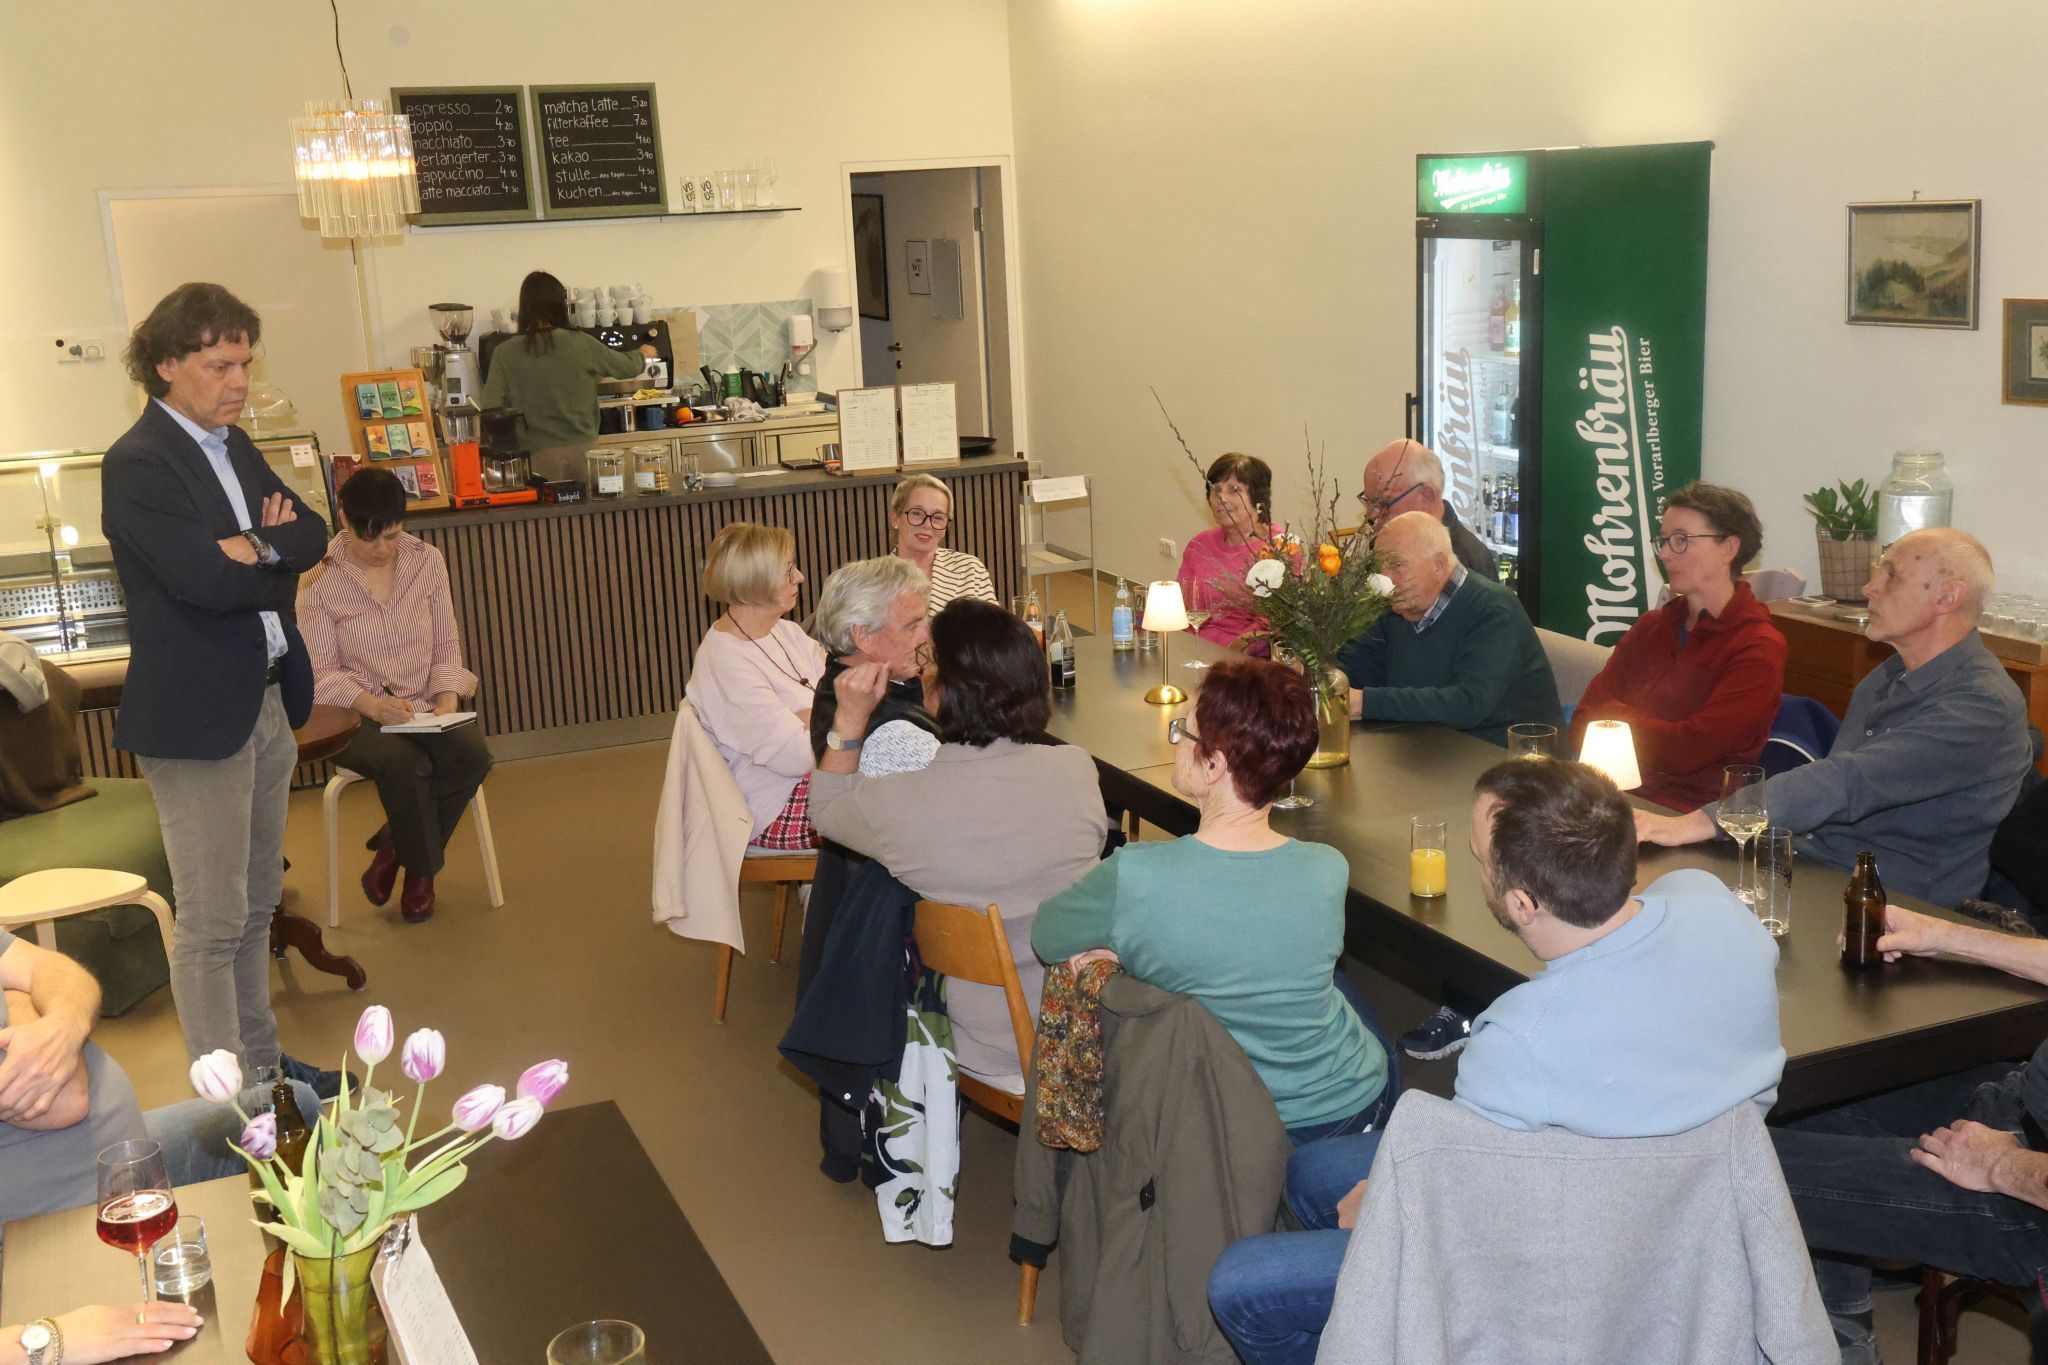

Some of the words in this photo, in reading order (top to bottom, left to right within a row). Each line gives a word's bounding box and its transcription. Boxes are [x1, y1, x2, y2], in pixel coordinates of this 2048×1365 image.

[406, 103, 471, 119] espresso
[545, 100, 589, 115] matcha
[592, 97, 619, 111] latte
[547, 115, 609, 130] filterkaffee
[548, 133, 569, 148] tee
[552, 151, 589, 165] kakao
[555, 168, 591, 184] stulle
[420, 186, 443, 200] atte
[446, 182, 491, 198] macciato
[1638, 337, 1653, 375] Bier
[1437, 347, 1472, 528] enbräu
[1644, 380, 1665, 492] Vorarlberger
[1576, 325, 1639, 647] Mohrenbräu
